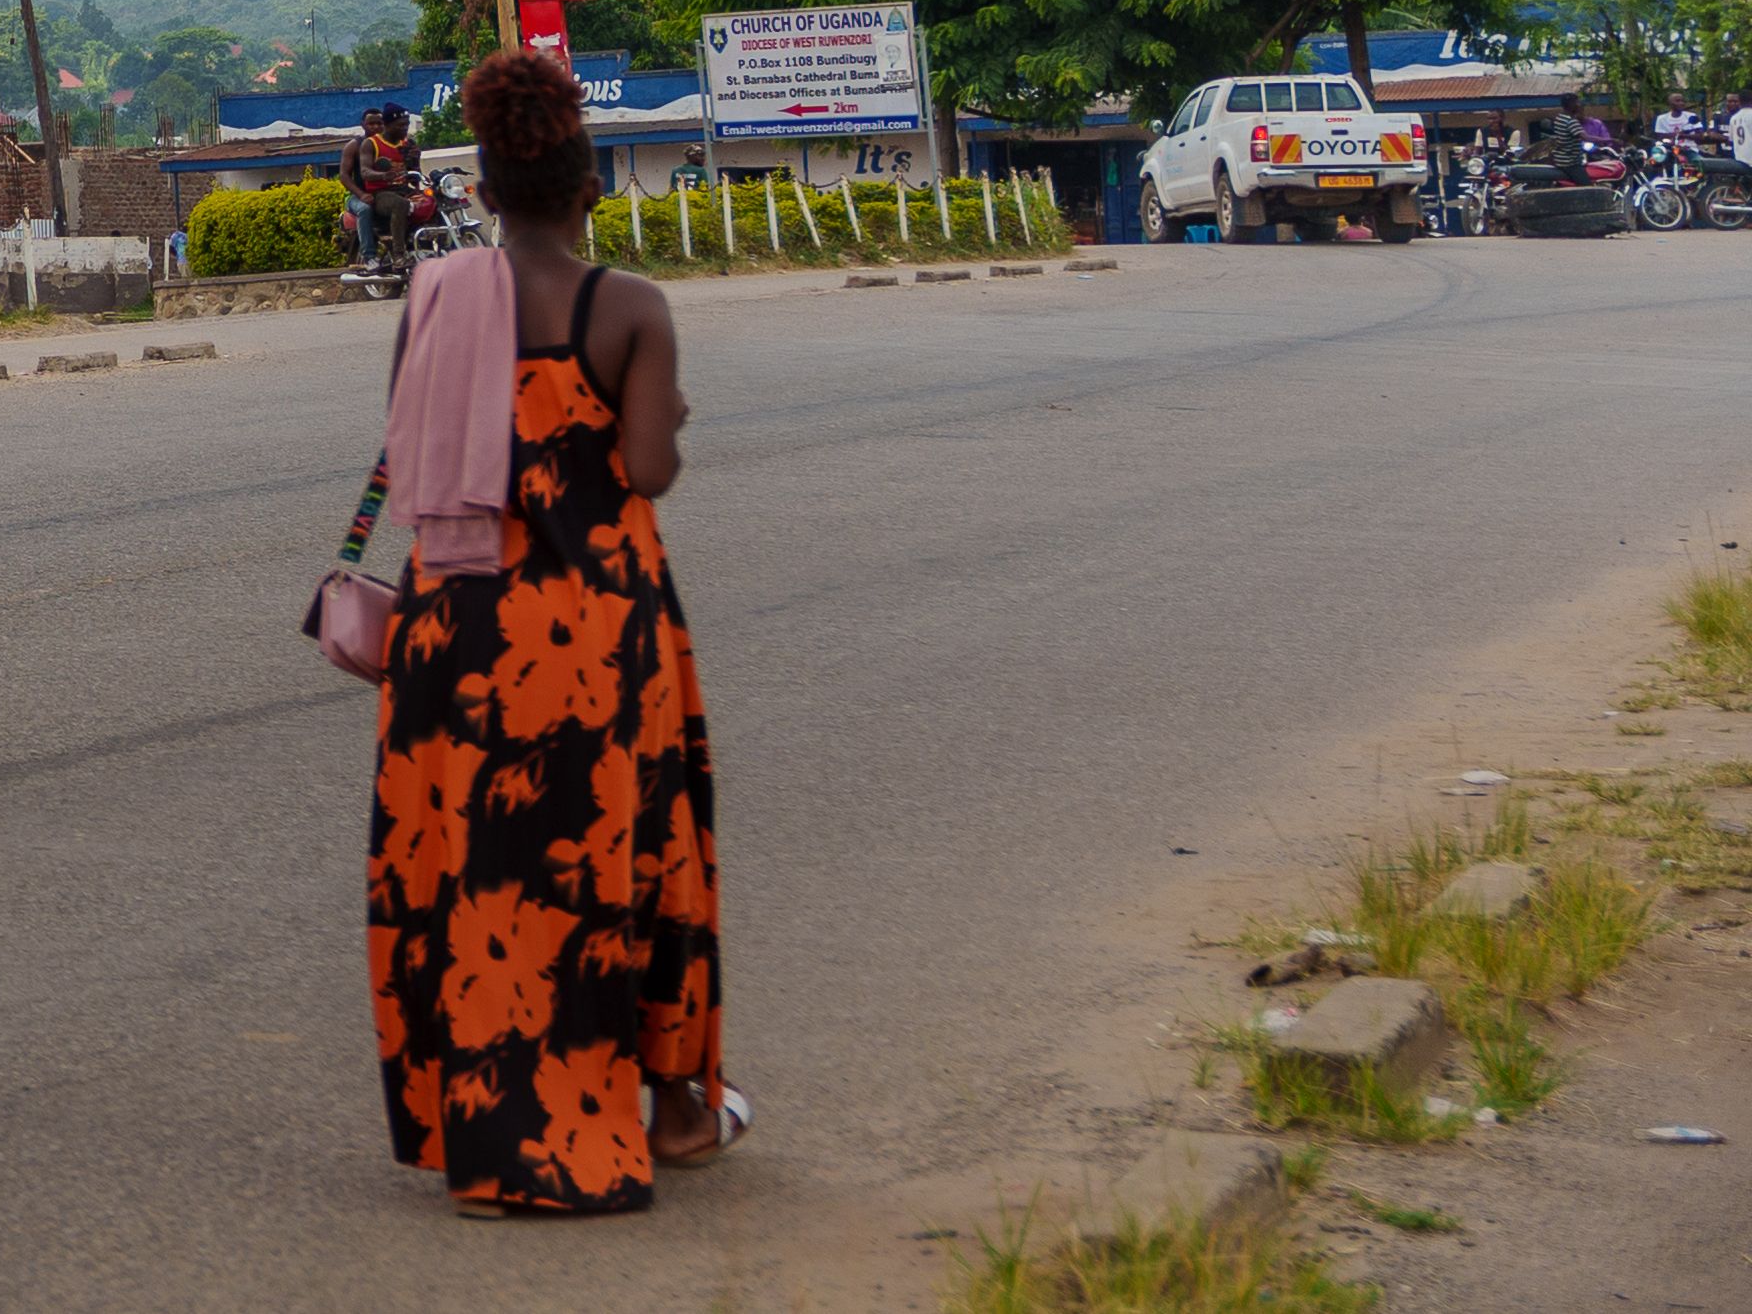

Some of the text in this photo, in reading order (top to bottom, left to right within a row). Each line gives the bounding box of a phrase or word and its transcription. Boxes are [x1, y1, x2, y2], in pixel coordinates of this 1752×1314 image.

[731, 11, 883, 34] CHURCH OF UGANDA
[741, 34, 872, 51] DIOCESE OF WEST RUWENZORI
[738, 58, 781, 69] P.O.Box
[785, 56, 813, 67] 1108
[726, 76, 741, 86] St.
[743, 74, 792, 85] Barnabas
[795, 71, 847, 83] Cathedral
[717, 90, 737, 101] and
[739, 88, 786, 100] Diocesan
[789, 86, 827, 98] Offices
[830, 86, 841, 97] at
[833, 102, 859, 113] 2km
[1736, 126, 1745, 145] 9
[855, 144, 912, 173] It's
